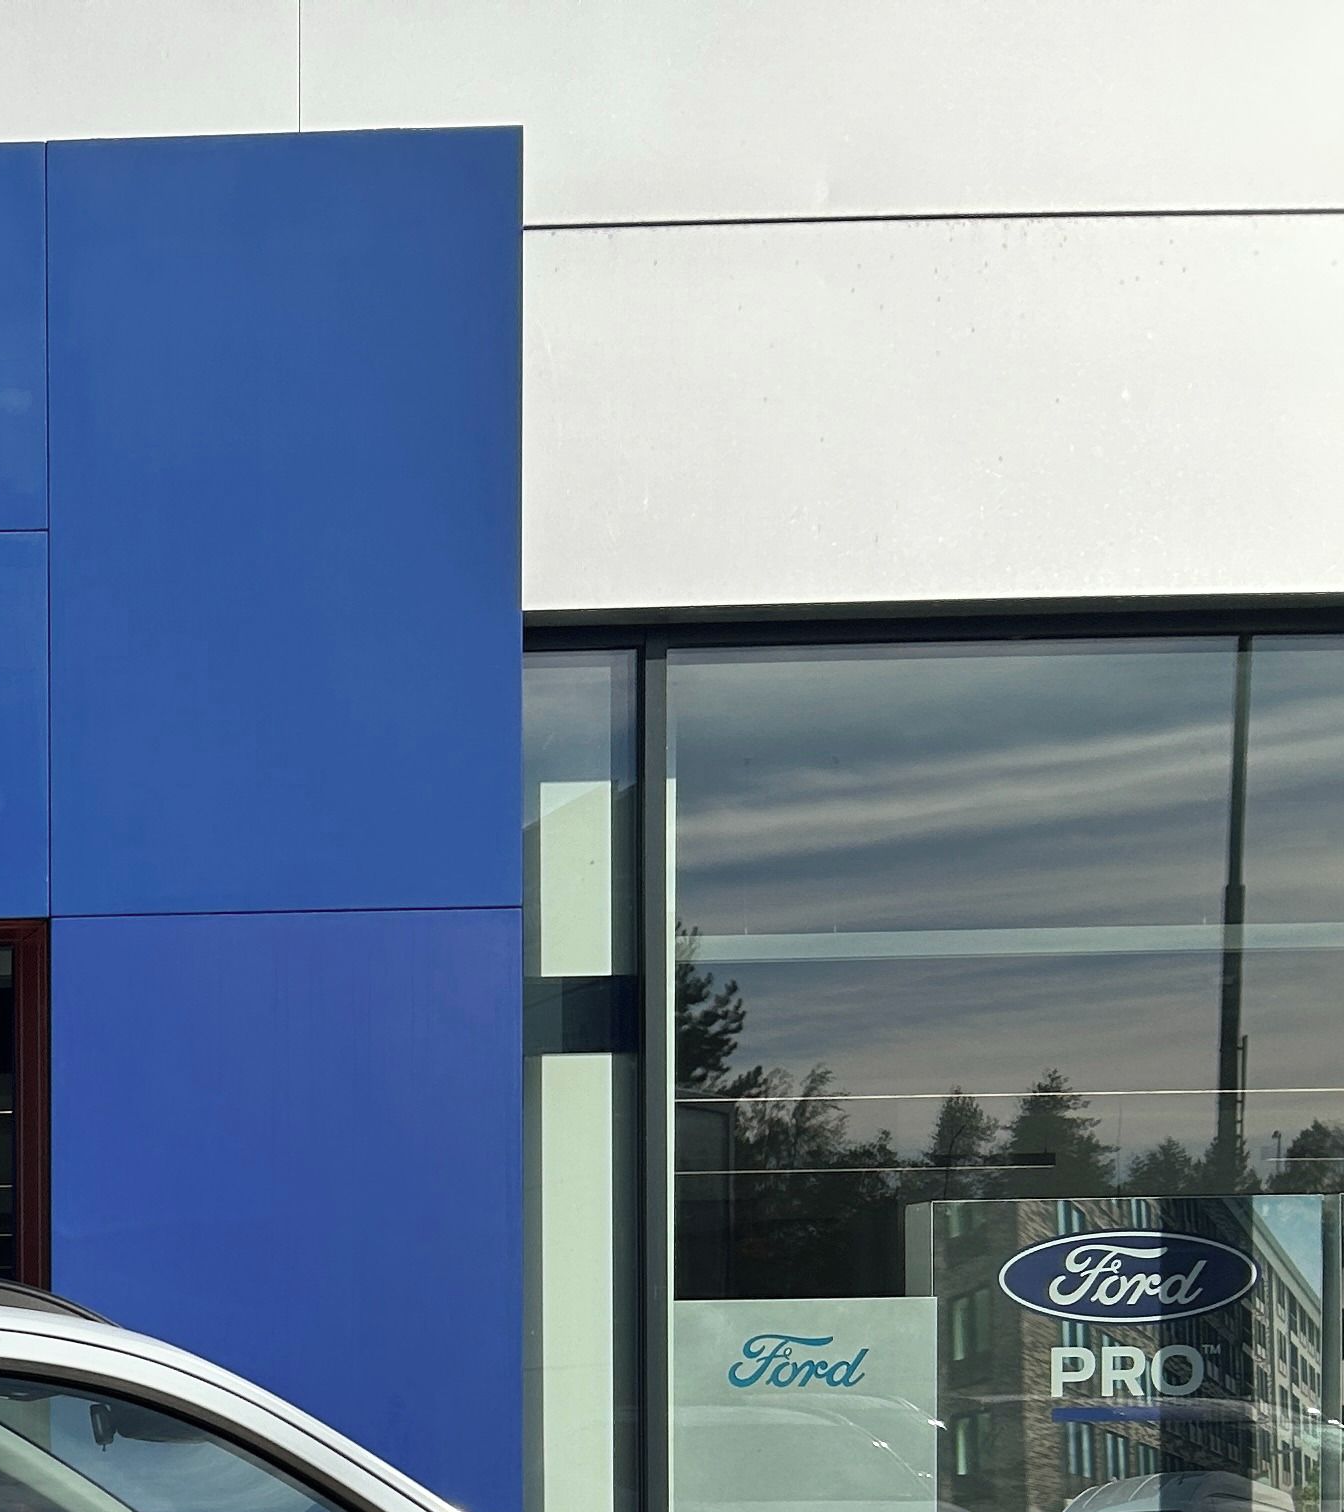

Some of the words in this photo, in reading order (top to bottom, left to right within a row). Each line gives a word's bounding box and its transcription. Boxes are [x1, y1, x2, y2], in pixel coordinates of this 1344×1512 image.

[1048, 1244, 1208, 1306] Ford
[728, 1334, 869, 1388] Ford
[1051, 1344, 1205, 1398] PRO
